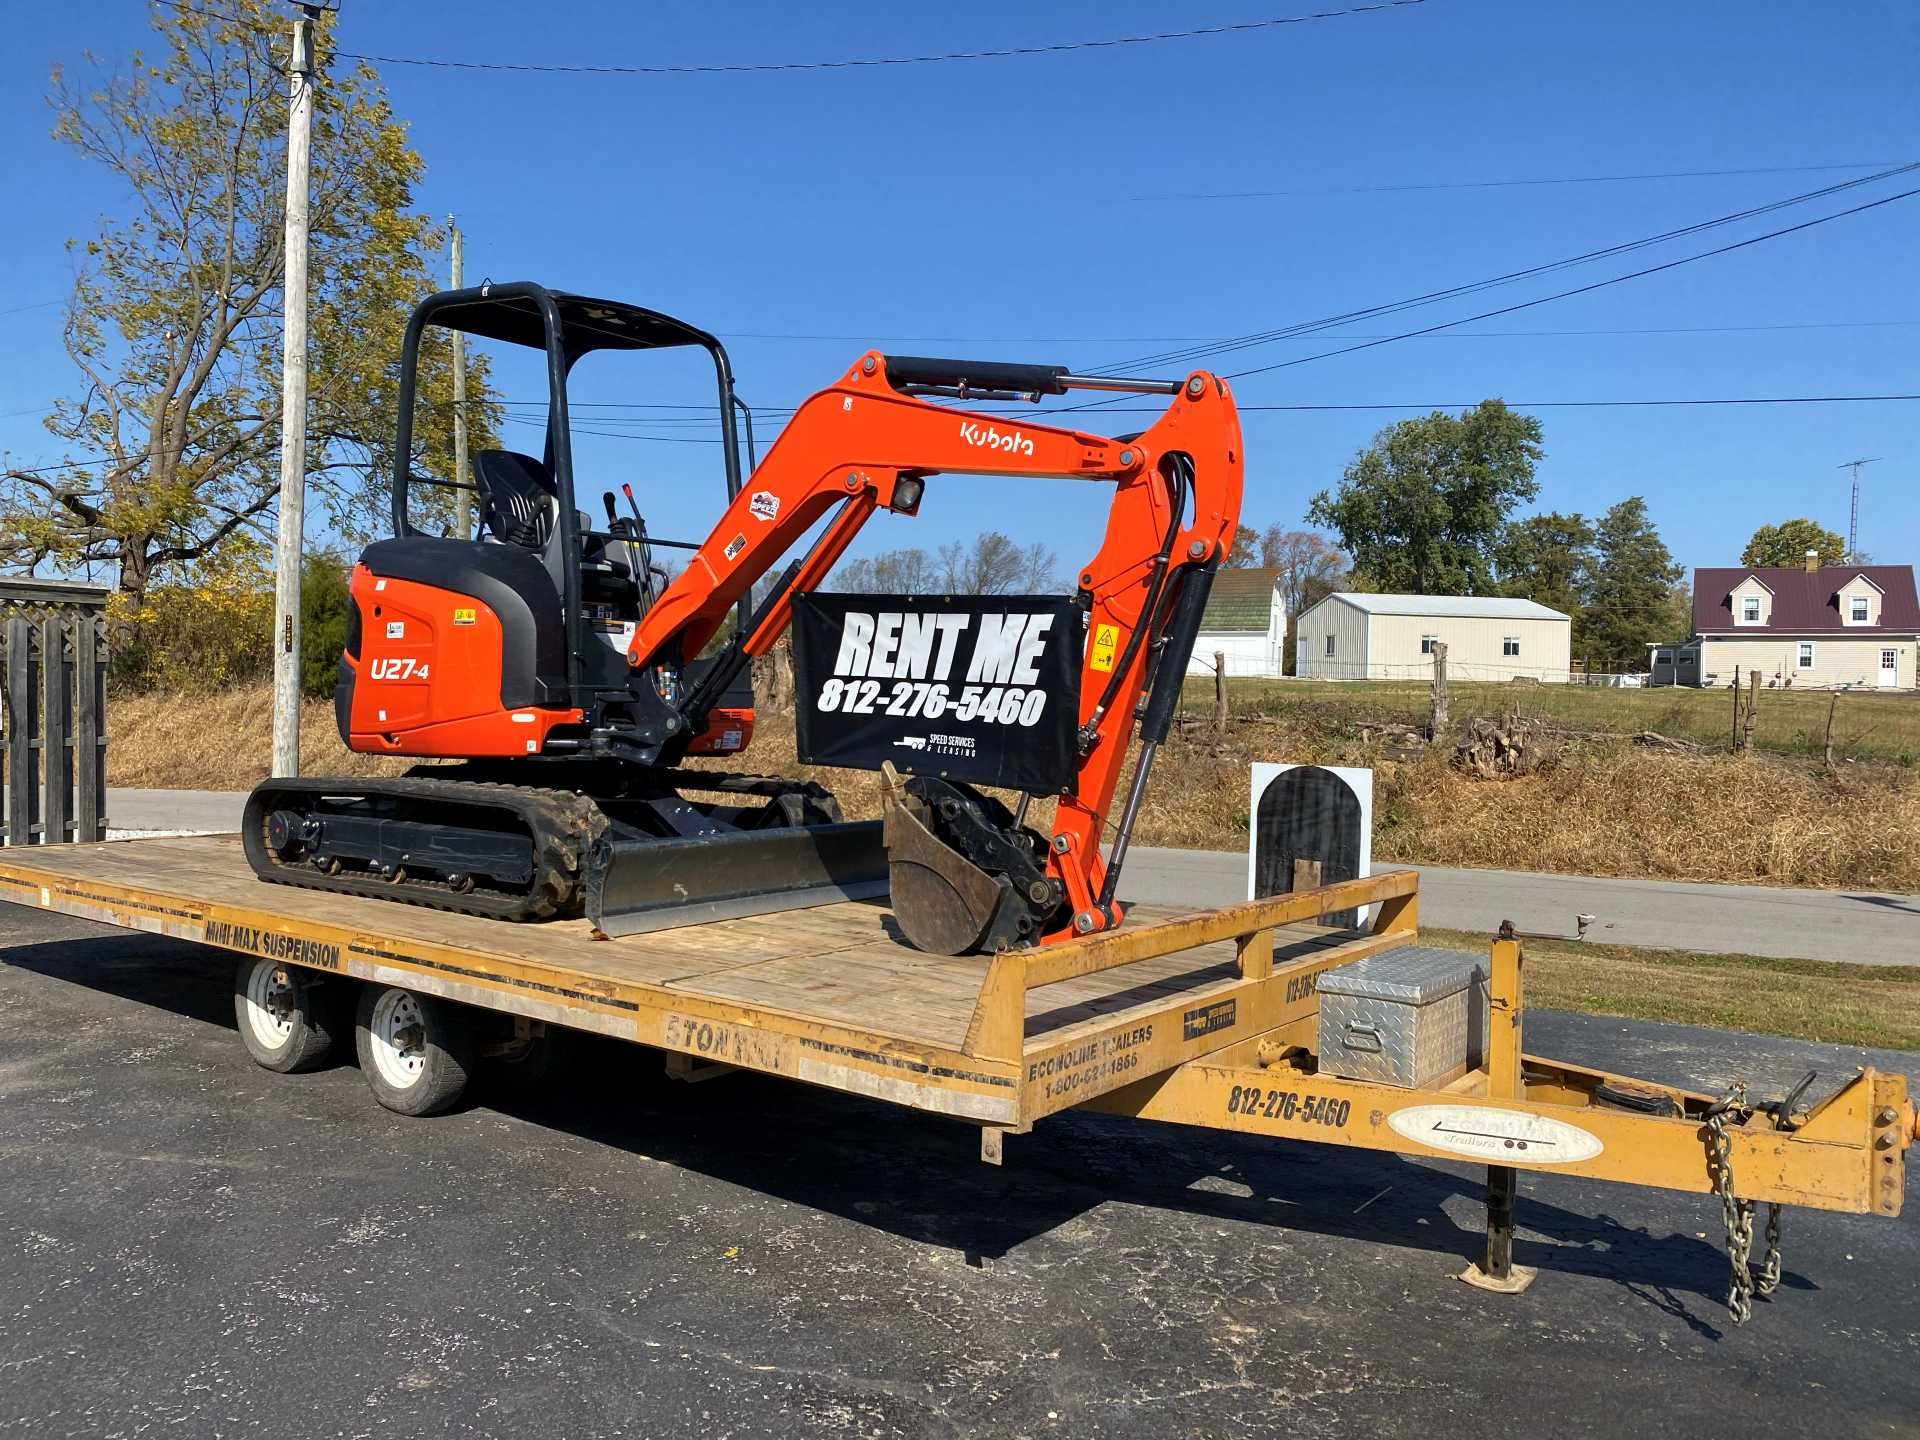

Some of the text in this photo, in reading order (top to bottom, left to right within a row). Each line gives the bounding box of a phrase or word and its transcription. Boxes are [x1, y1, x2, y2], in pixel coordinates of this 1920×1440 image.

[960, 422, 1034, 456] Kubota
[833, 612, 1055, 685] RENT ME
[371, 658, 430, 680] U27-4
[817, 679, 1047, 727] 812-276-5460
[926, 744, 976, 758] & LEASING
[929, 733, 976, 748] SPEED SERVICES
[263, 932, 340, 969] SUSPENSION
[1286, 967, 1329, 1004] 812-276-5
[1029, 1042, 1098, 1083] ECONOLINE
[1227, 1085, 1351, 1128] 812-276-5460
